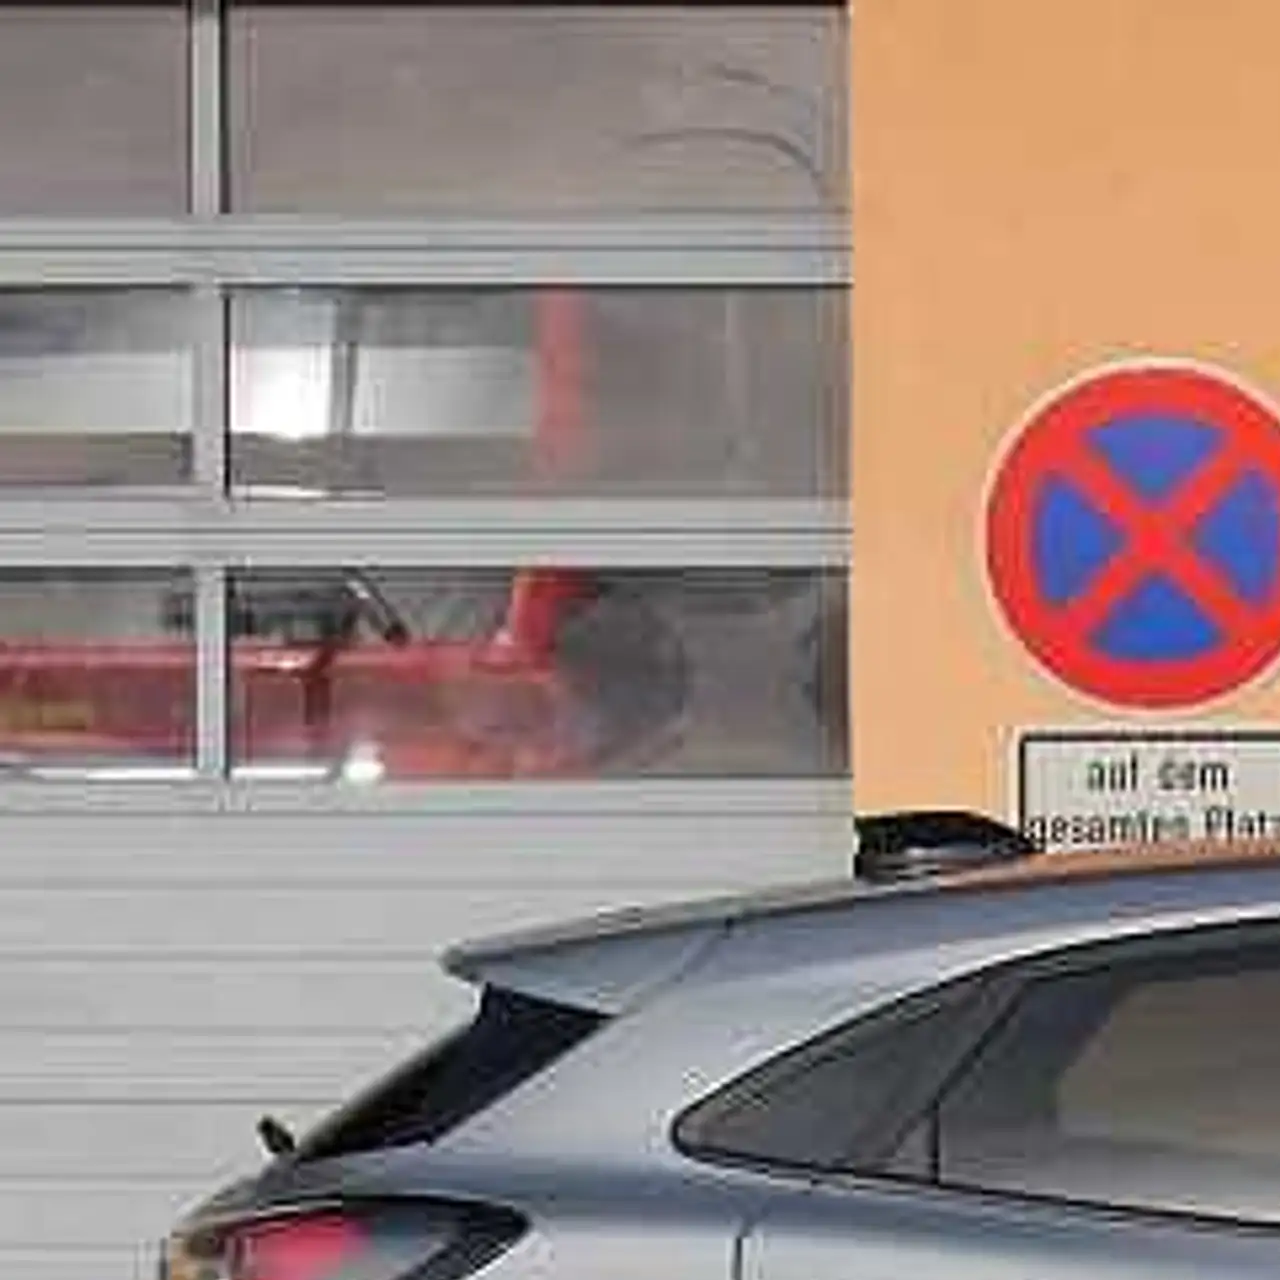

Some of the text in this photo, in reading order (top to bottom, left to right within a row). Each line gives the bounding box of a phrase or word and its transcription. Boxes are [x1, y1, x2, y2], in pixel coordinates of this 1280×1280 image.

[1087, 752, 1230, 791] auf dem
[1028, 808, 1189, 852] gesamten
